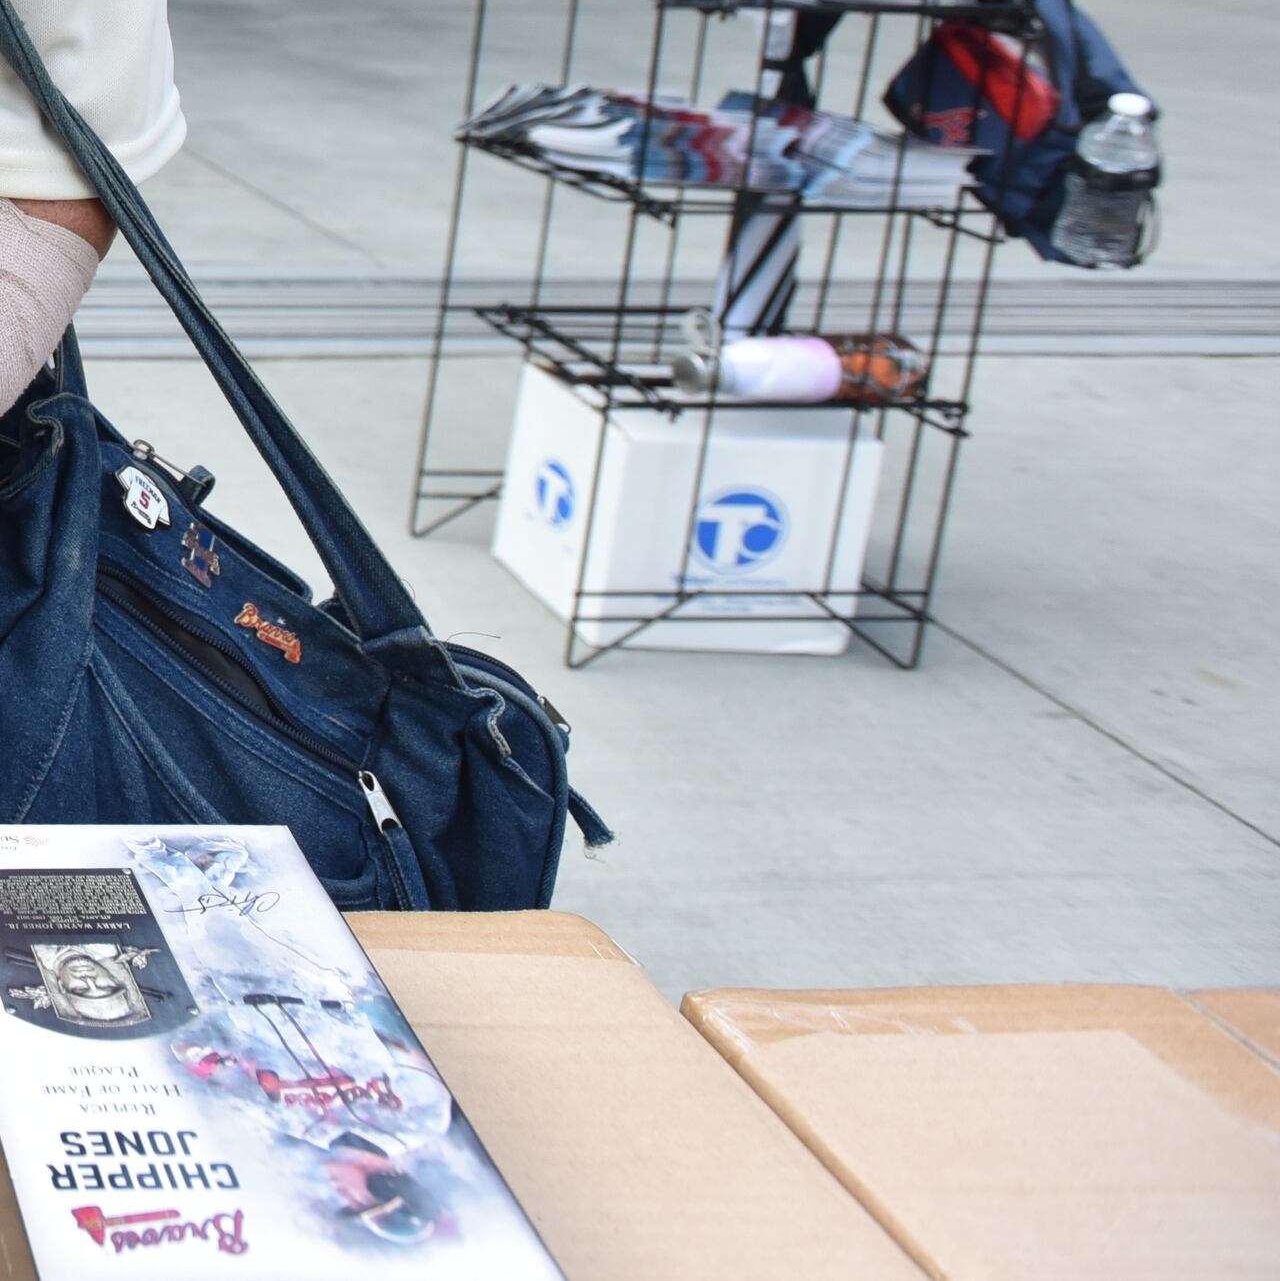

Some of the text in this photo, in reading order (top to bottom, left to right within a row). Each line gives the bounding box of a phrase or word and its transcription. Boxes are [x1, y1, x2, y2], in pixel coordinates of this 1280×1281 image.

[138, 489, 152, 510] 5
[234, 602, 299, 647] Braves
[59, 1130, 199, 1157] JONES
[45, 1163, 241, 1191] CHIPPER
[110, 1209, 249, 1255] Braves
